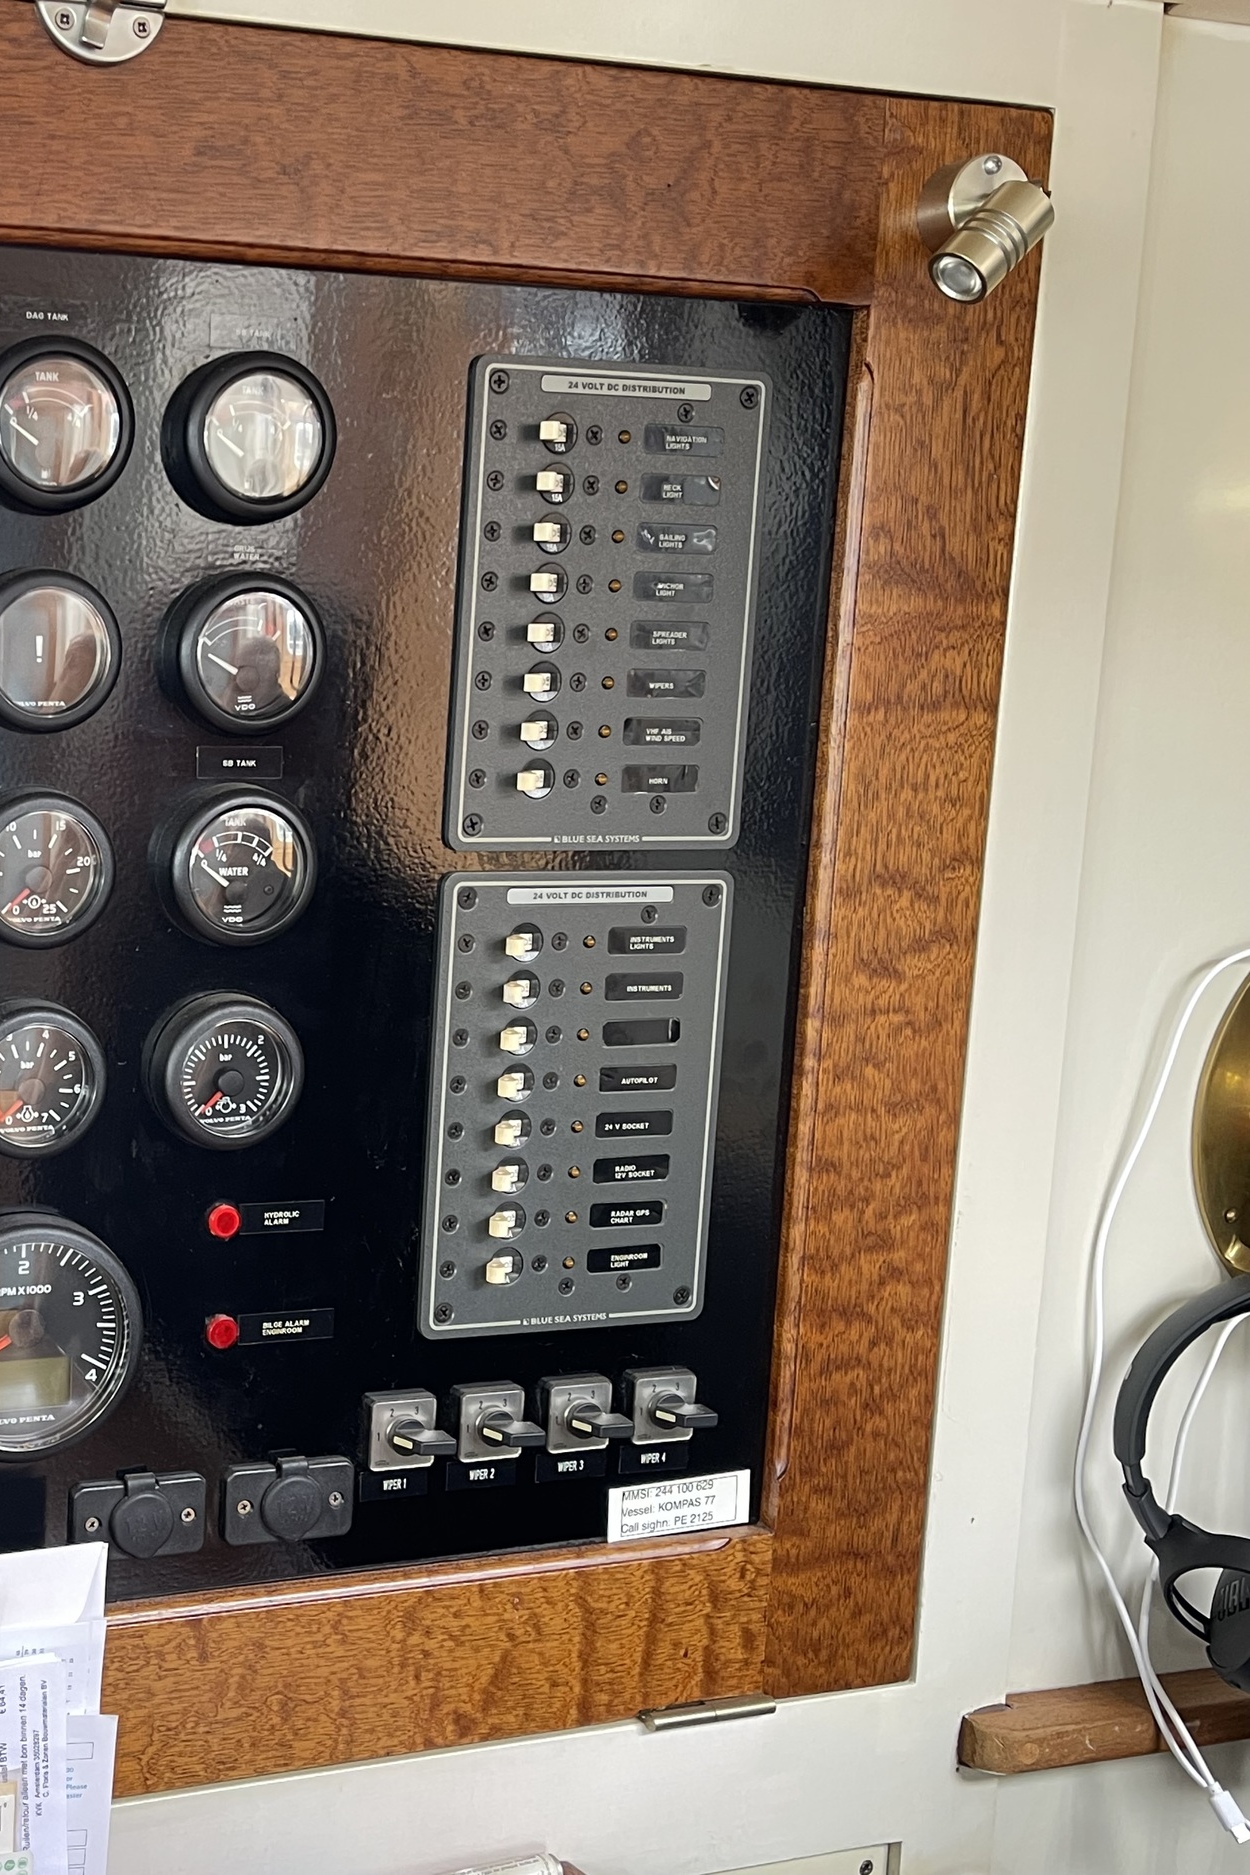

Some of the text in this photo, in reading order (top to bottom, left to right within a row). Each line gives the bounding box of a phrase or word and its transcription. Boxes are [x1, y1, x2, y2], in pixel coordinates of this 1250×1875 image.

[47, 312, 69, 321] TANK
[35, 371, 59, 382] TANK
[568, 381, 686, 395] 24 VOLT DC DISTRIBUTION
[666, 435, 707, 443] NAVIGATION
[653, 631, 687, 639] SPREADER
[235, 703, 256, 711] VDO
[236, 759, 257, 767] TANK
[55, 820, 67, 831] 15
[224, 817, 247, 826] TANK
[562, 835, 640, 843] BLUE SEA SYSTEMS
[27, 849, 42, 858] bar
[215, 849, 227, 863] 1/4
[76, 856, 91, 867] 20
[252, 852, 266, 867] 4/4
[219, 866, 249, 876] WATER
[532, 890, 648, 900] 24 VOLT DC DISTRIBUTION
[42, 903, 57, 914] 25
[629, 935, 675, 943] INSTRUMENTS
[42, 1030, 50, 1039] 4
[257, 1035, 265, 1045] 2
[68, 1051, 76, 1061] 5
[219, 1053, 233, 1062] bar
[20, 1060, 34, 1069] bar
[621, 1076, 659, 1085] AUTOPILOT
[604, 1123, 613, 1131] 24
[622, 1122, 650, 1130] SOCKET
[614, 1164, 637, 1172] RADIO
[628, 1170, 655, 1178] SOCKET
[264, 1210, 300, 1219] HYDROLIC
[264, 1218, 289, 1226] ALARM
[610, 1216, 633, 1224] CHART
[18, 1261, 30, 1275] 2
[610, 1260, 629, 1268] LIGHT
[72, 1291, 85, 1306] 3
[530, 1312, 607, 1325] BLUE SEA SYSTEMS
[262, 1319, 310, 1329] BILGE ALARM
[262, 1327, 303, 1336] ENGINROOM
[84, 1368, 98, 1382] 4
[19, 1414, 55, 1424] PENTA
[640, 1452, 666, 1464] WIPER 4
[557, 1459, 584, 1473] WIPER 3
[469, 1467, 495, 1480] WIPER 2
[382, 1478, 407, 1491] WIPER 1
[623, 1480, 714, 1501] MMSI: 244 100 629
[622, 1495, 716, 1517] Vessel: KOMPAS 77
[621, 1511, 714, 1534] Call sighn: PE 2125
[17, 1674, 29, 1702] dagen.
[18, 1702, 27, 1713] 14
[19, 1714, 28, 1742] binnen
[0, 1742, 8, 1761] BTW
[19, 1743, 28, 1759] bon
[20, 1760, 29, 1775] met
